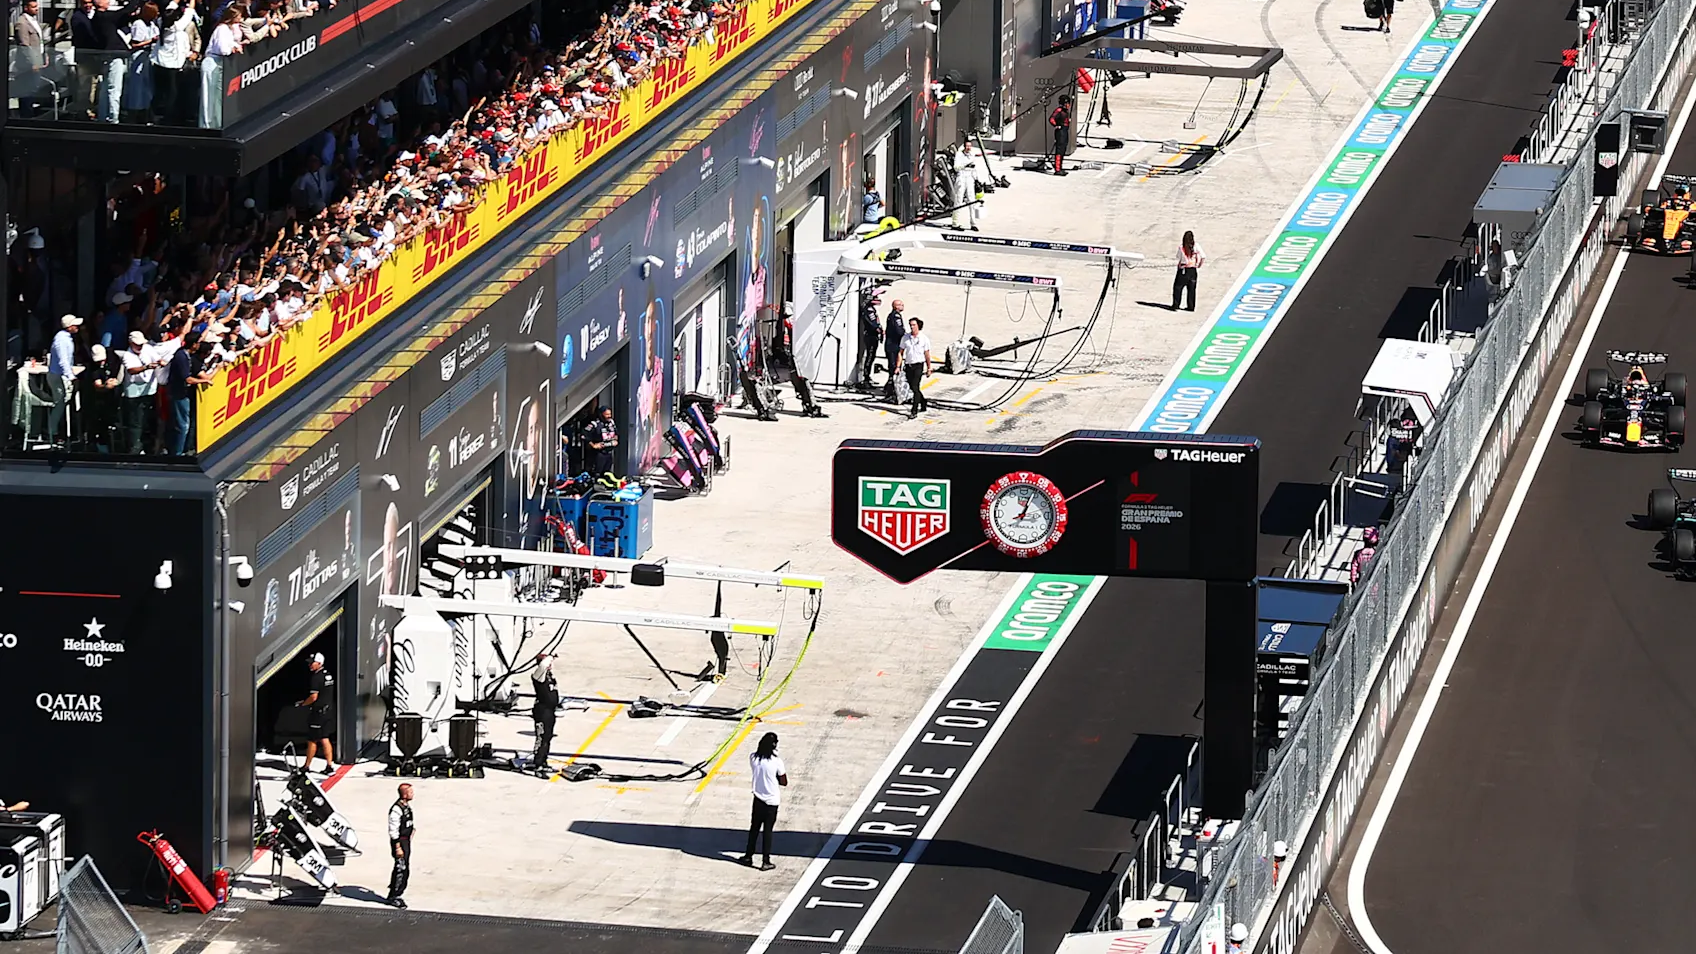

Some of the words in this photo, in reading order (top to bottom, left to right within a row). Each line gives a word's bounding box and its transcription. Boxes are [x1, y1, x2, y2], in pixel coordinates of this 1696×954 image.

[240, 46, 292, 89] PADDOCK
[290, 33, 317, 62] CLUB
[1380, 78, 1427, 108] aramco
[1356, 113, 1402, 144] aramco
[1326, 152, 1377, 185] aramco
[1297, 191, 1348, 227] aramco
[696, 222, 727, 256] COLAPINTO
[1264, 236, 1318, 273] aramco
[1229, 282, 1286, 323] aramco
[459, 323, 490, 357] CADILLAC
[590, 325, 611, 352] GASLY
[1191, 333, 1251, 376] aramco
[1150, 386, 1215, 433] aramco
[303, 443, 340, 481] CADILLAC
[1171, 449, 1246, 464] TAGHeuer
[867, 483, 942, 507] TAG
[984, 489, 994, 501] 50
[998, 476, 1010, 486] 55
[1037, 477, 1049, 489] 05
[1054, 493, 1063, 503] 10
[1121, 508, 1148, 517] GRAN
[1148, 509, 1184, 519] PREMIO
[1121, 515, 1134, 523] DE
[1121, 522, 1142, 531] 2026
[863, 510, 945, 550] HEUER
[288, 565, 302, 606] 77
[303, 562, 338, 599] BOTTAS
[707, 572, 741, 580] CADILLAC
[655, 618, 691, 626] CADILLAC
[1001, 580, 1080, 641] aramco
[63, 638, 125, 653] Heineken
[36, 692, 102, 712] QATAR
[51, 709, 103, 723] AIRWAYS
[920, 697, 1002, 748] FOR
[1335, 702, 1378, 848] TAGHeuer
[844, 762, 957, 857] DRIVE
[329, 817, 348, 834] 3M
[306, 857, 329, 875] 3M
[805, 874, 880, 909] TO
